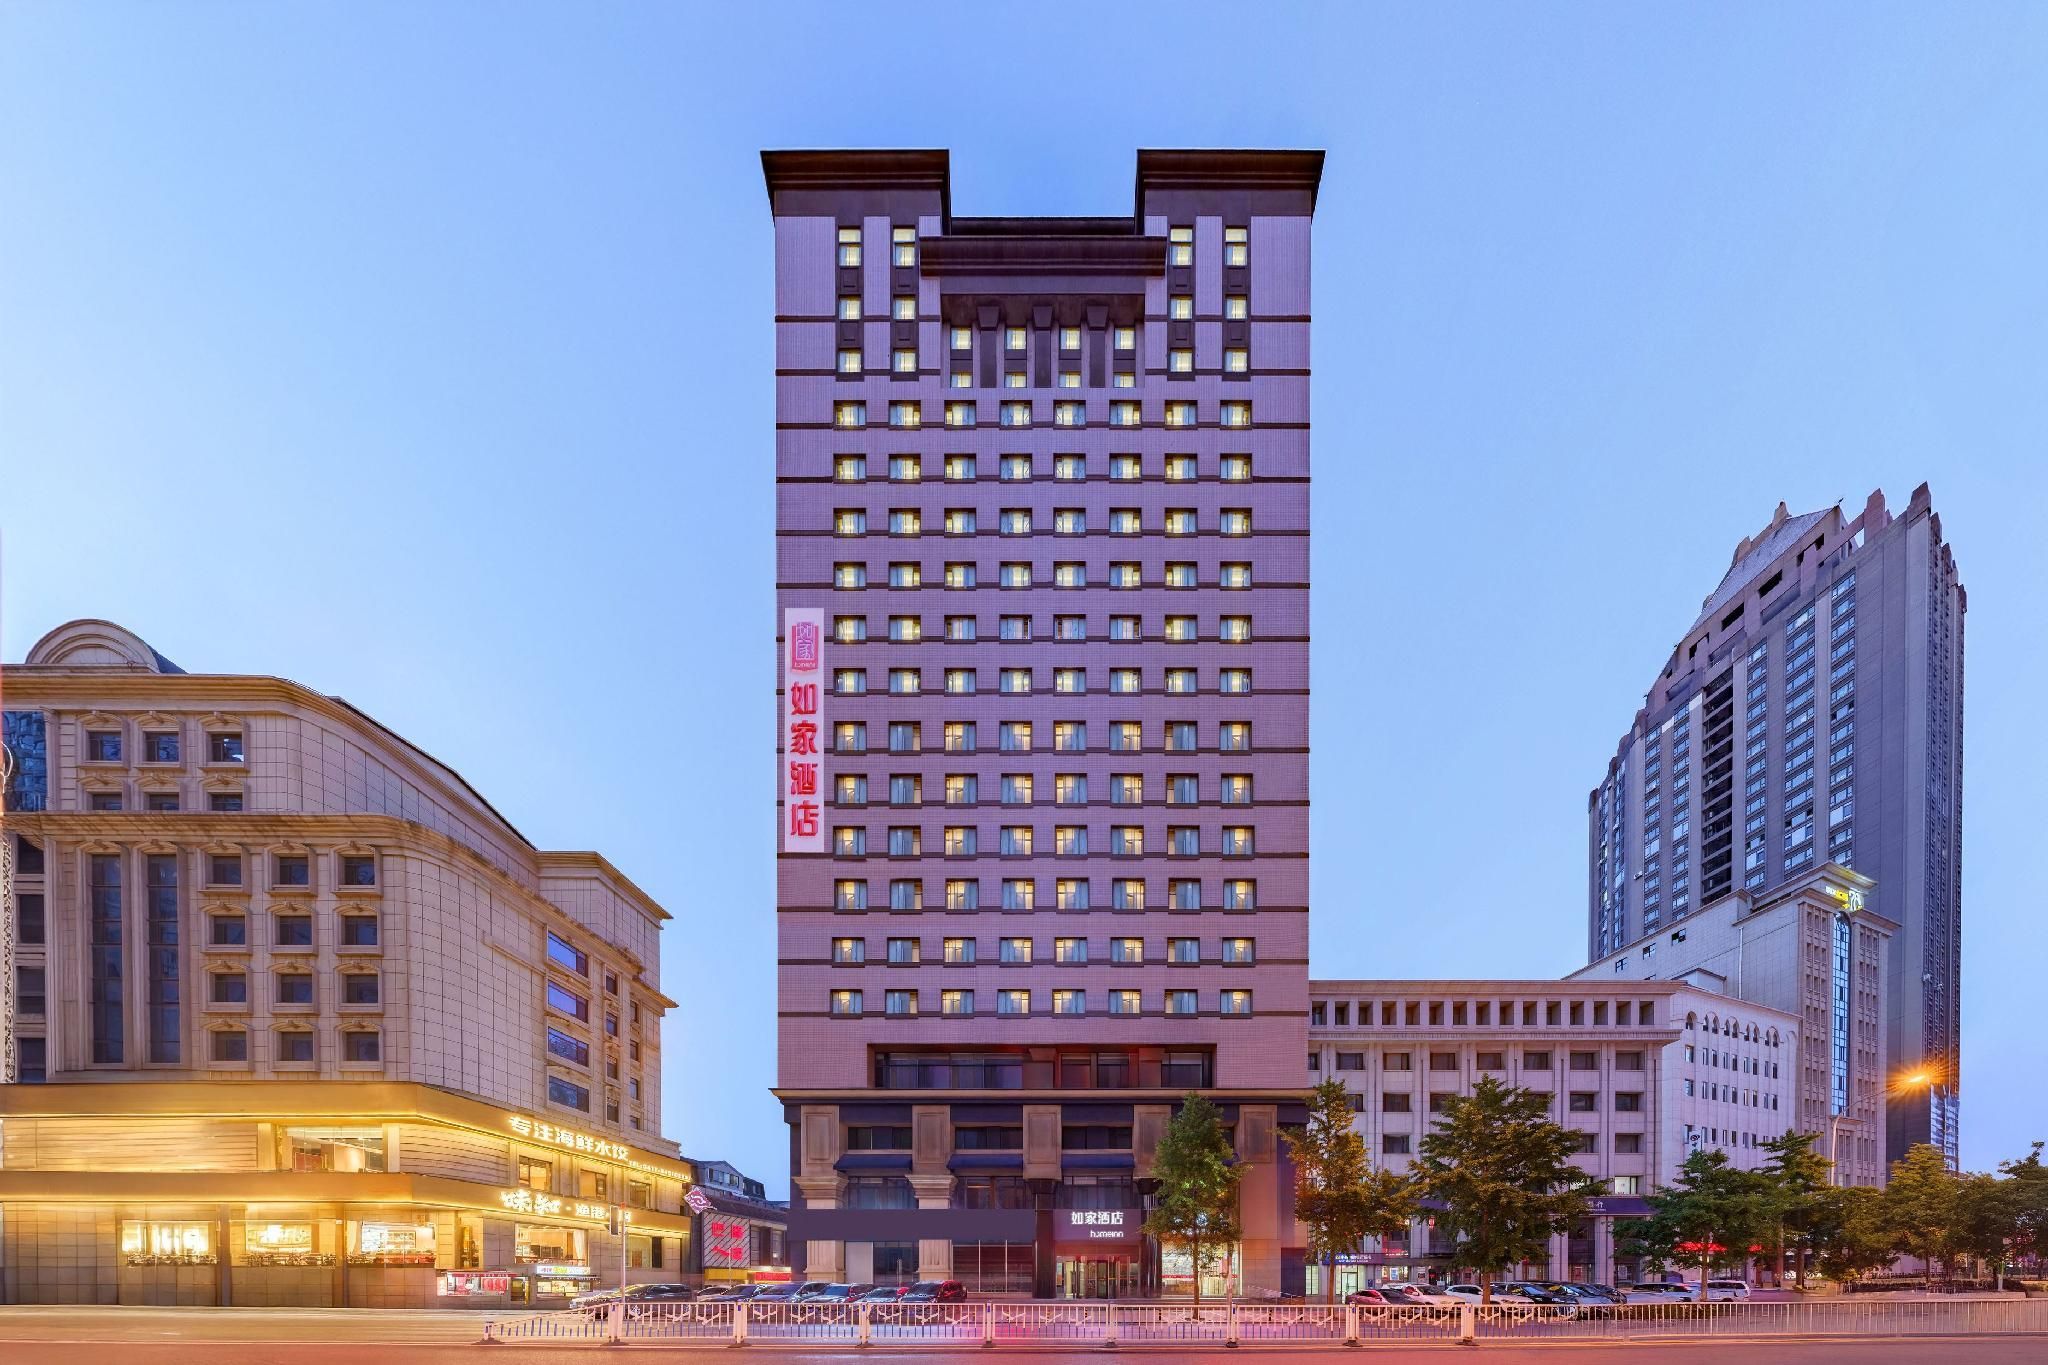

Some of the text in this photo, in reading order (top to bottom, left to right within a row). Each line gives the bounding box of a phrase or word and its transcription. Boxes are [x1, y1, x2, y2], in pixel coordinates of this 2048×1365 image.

[790, 681, 819, 837] 如家酒店
[509, 1116, 630, 1160] 专注海鲜水饺
[1071, 1211, 1124, 1225] 如家酒店
